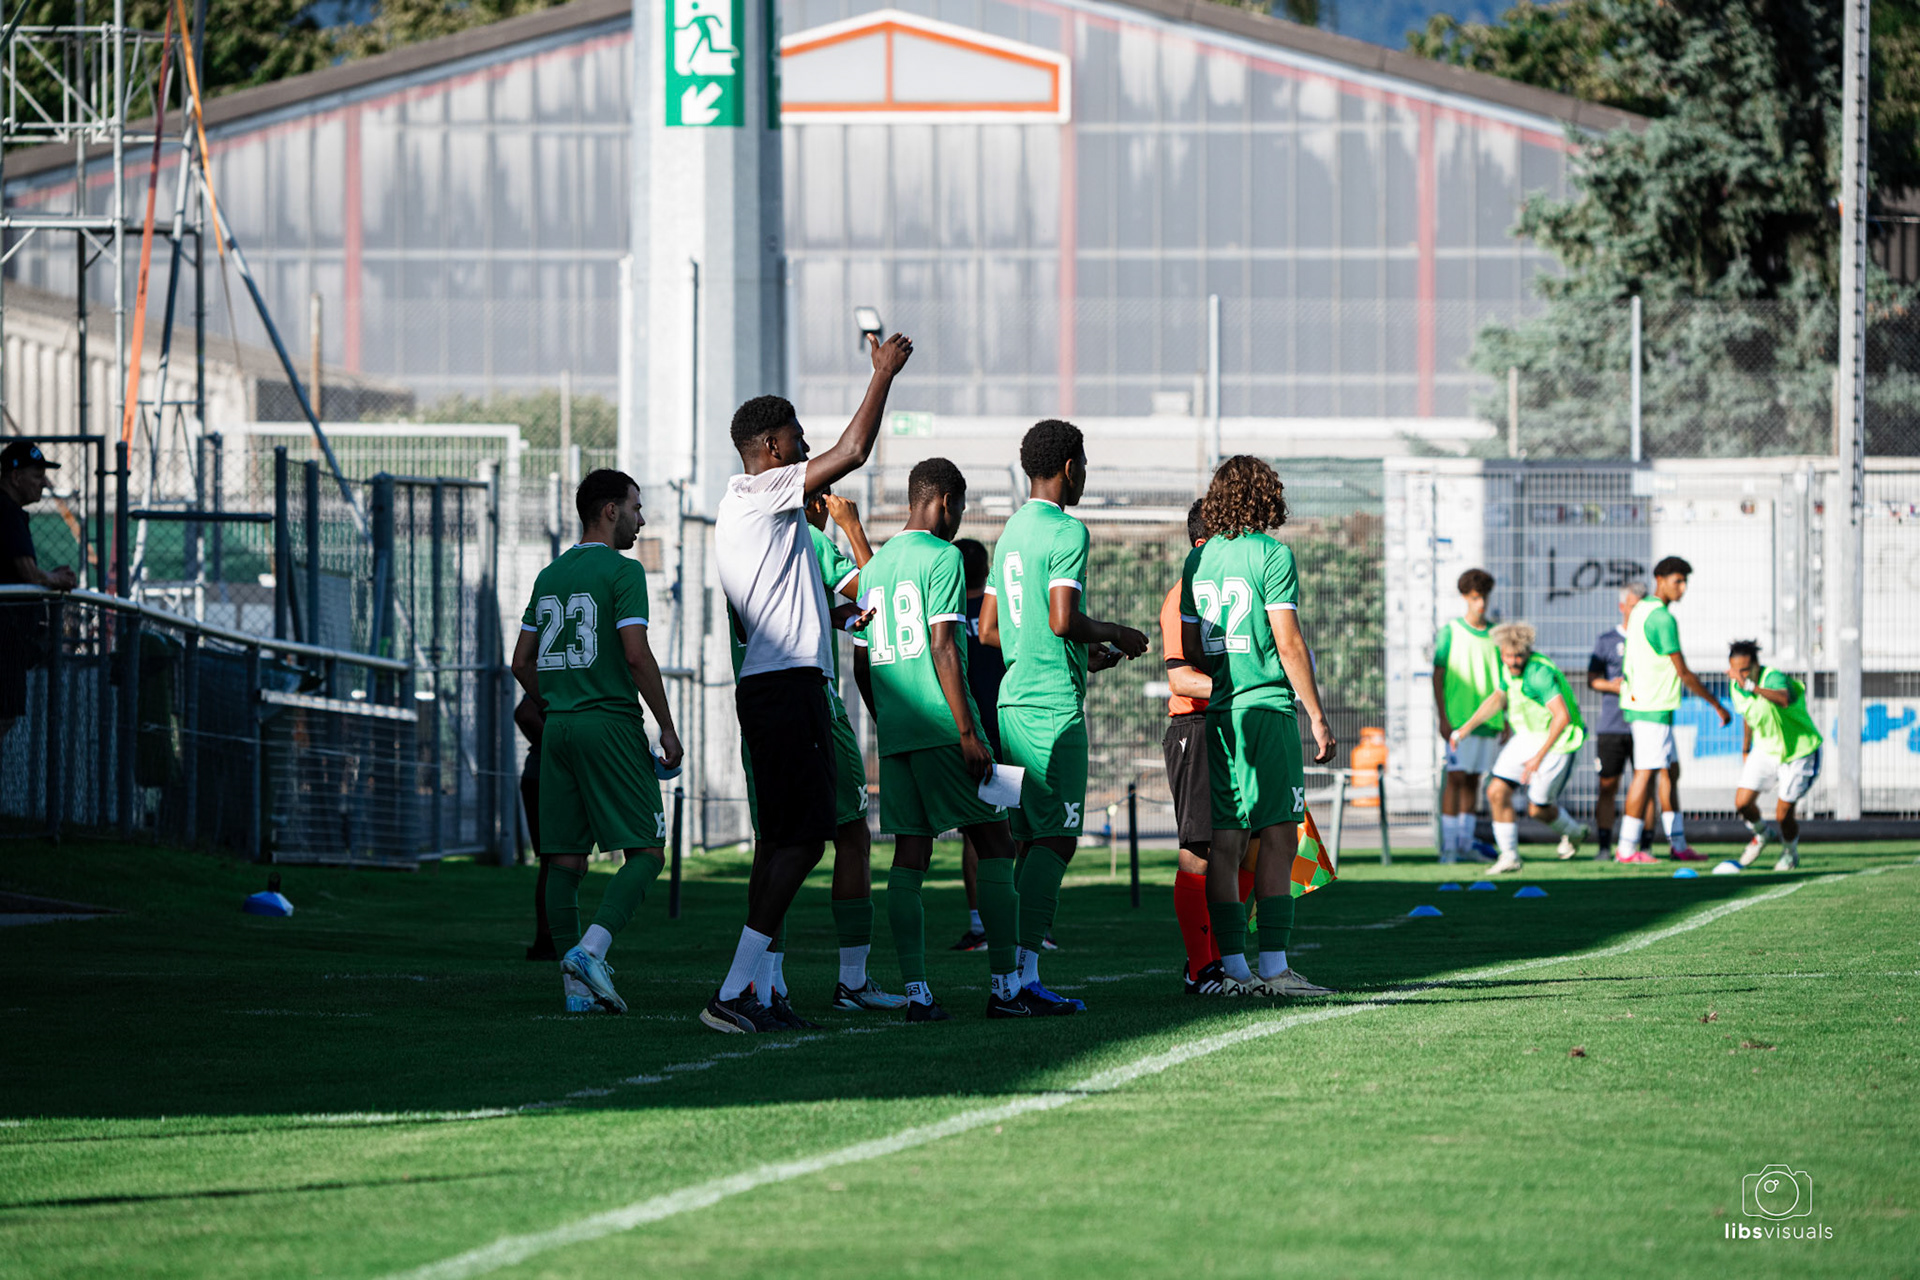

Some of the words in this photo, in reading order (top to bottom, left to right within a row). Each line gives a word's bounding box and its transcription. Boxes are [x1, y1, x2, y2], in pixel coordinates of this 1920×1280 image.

[868, 580, 927, 667] 18
[1003, 551, 1024, 629] 6
[1192, 577, 1253, 656] 22
[535, 592, 598, 672] 23
